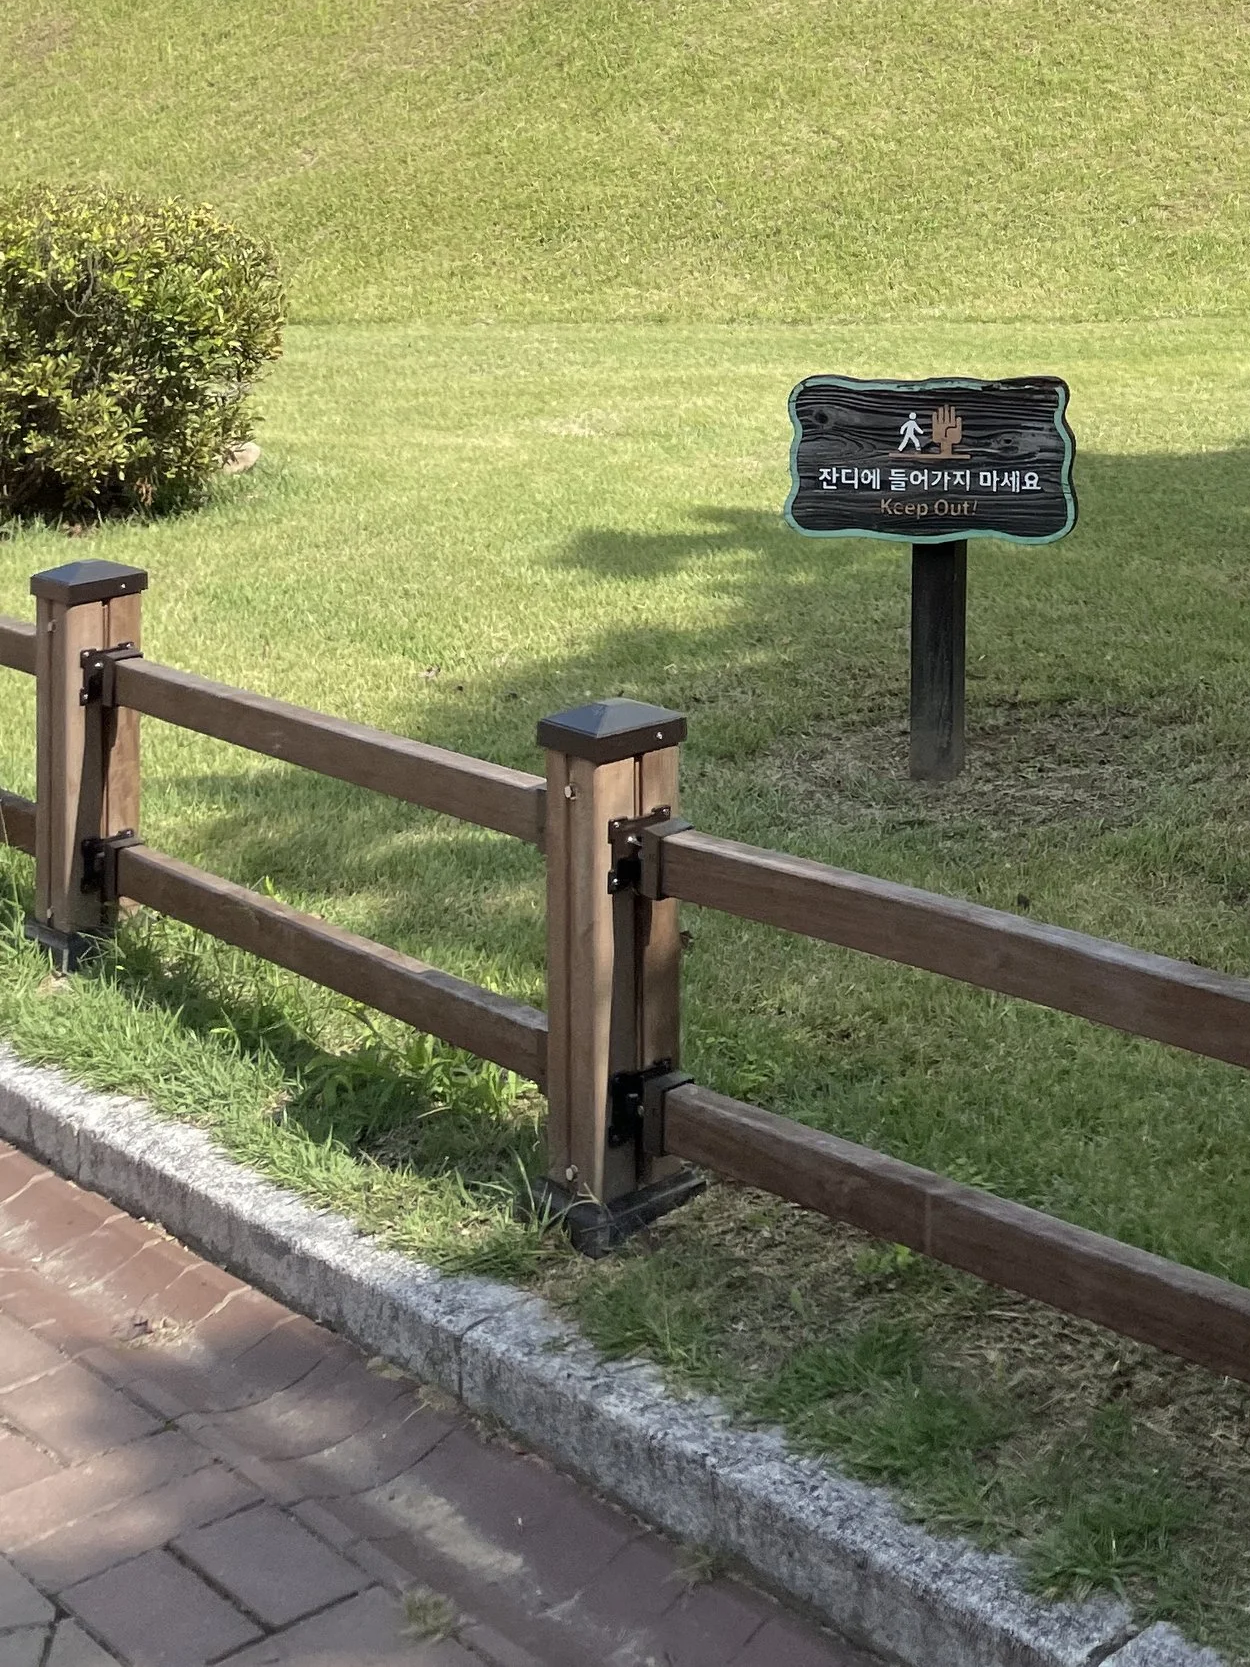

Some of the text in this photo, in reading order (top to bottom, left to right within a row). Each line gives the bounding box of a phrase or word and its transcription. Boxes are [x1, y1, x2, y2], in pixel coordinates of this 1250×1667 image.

[818, 467, 1042, 493] 잔디에 들어가지 마세요
[880, 498, 978, 520] Keep Out!
